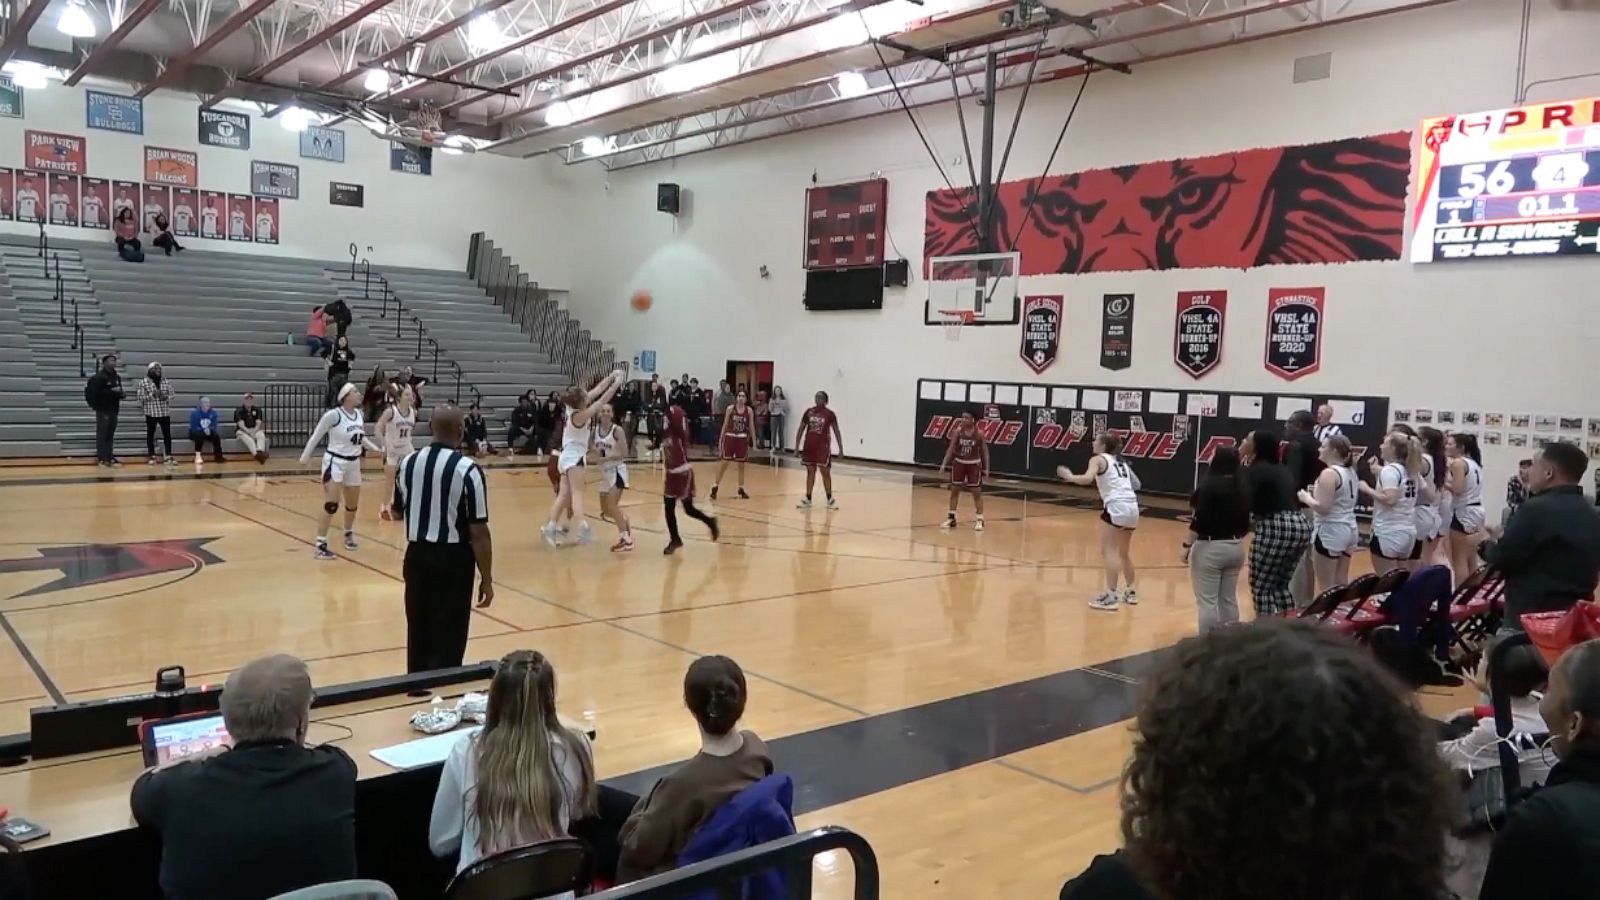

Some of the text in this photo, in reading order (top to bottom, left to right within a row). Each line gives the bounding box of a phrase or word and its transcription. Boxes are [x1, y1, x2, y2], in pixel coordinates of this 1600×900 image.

[95, 117, 136, 131] BULLDOGS
[201, 110, 247, 130] TUSCARORA
[31, 135, 80, 152] PARK VIEW
[34, 156, 78, 172] PATRIOTS
[147, 149, 196, 167] BRIAR WOODS
[155, 171, 187, 184] FALCONS
[1458, 160, 1515, 199] 56
[1552, 166, 1566, 184] 4
[1191, 295, 1211, 305] GOLF
[1182, 313, 1219, 323] VHSL 4A
[1273, 312, 1316, 324] VHSL 4A
[1031, 323, 1053, 332] STATE
[1186, 323, 1213, 334] STATE
[1278, 323, 1309, 334] STATE
[1181, 333, 1218, 343] RUNNER-UP
[1271, 333, 1315, 343] RUNNER-UP
[1188, 343, 1209, 353] 2016
[1278, 342, 1306, 353] 2020
[1033, 424, 1088, 450] OF
